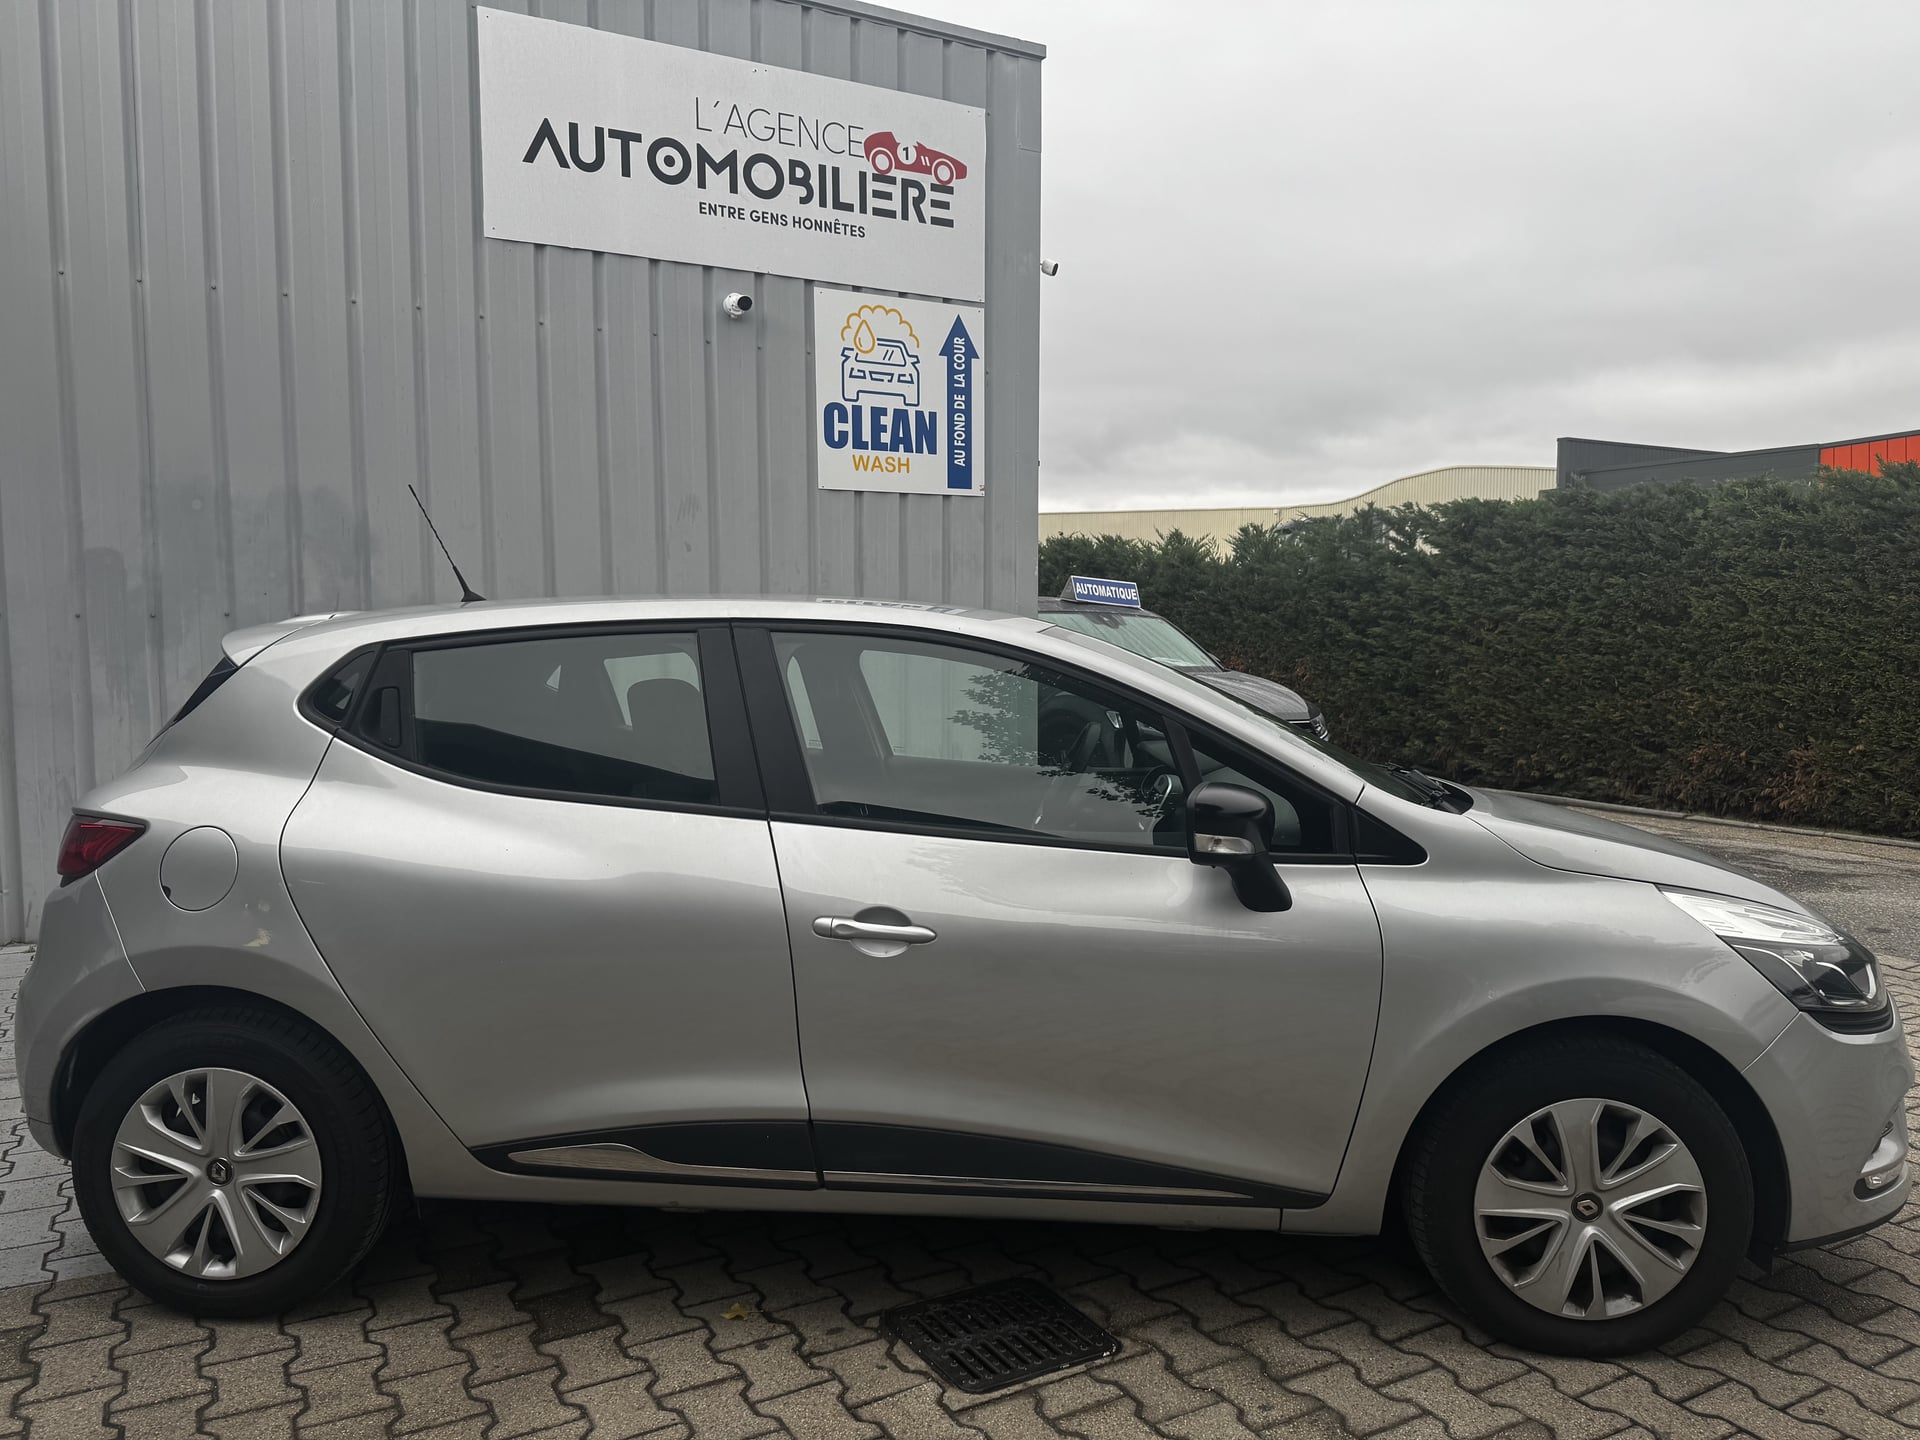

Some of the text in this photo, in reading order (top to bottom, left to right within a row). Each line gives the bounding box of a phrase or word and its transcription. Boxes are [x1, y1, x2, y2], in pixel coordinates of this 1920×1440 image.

[902, 146, 910, 161] 1
[523, 117, 955, 229] AUTOMOBILIERE
[699, 201, 866, 239] ENTRE GENS HONNÊTES
[953, 336, 966, 467] AU FOND DE LA COUR
[823, 401, 938, 455] CLEAN
[852, 454, 911, 474] WASH
[1076, 582, 1138, 600] AUTOMATIQUE
